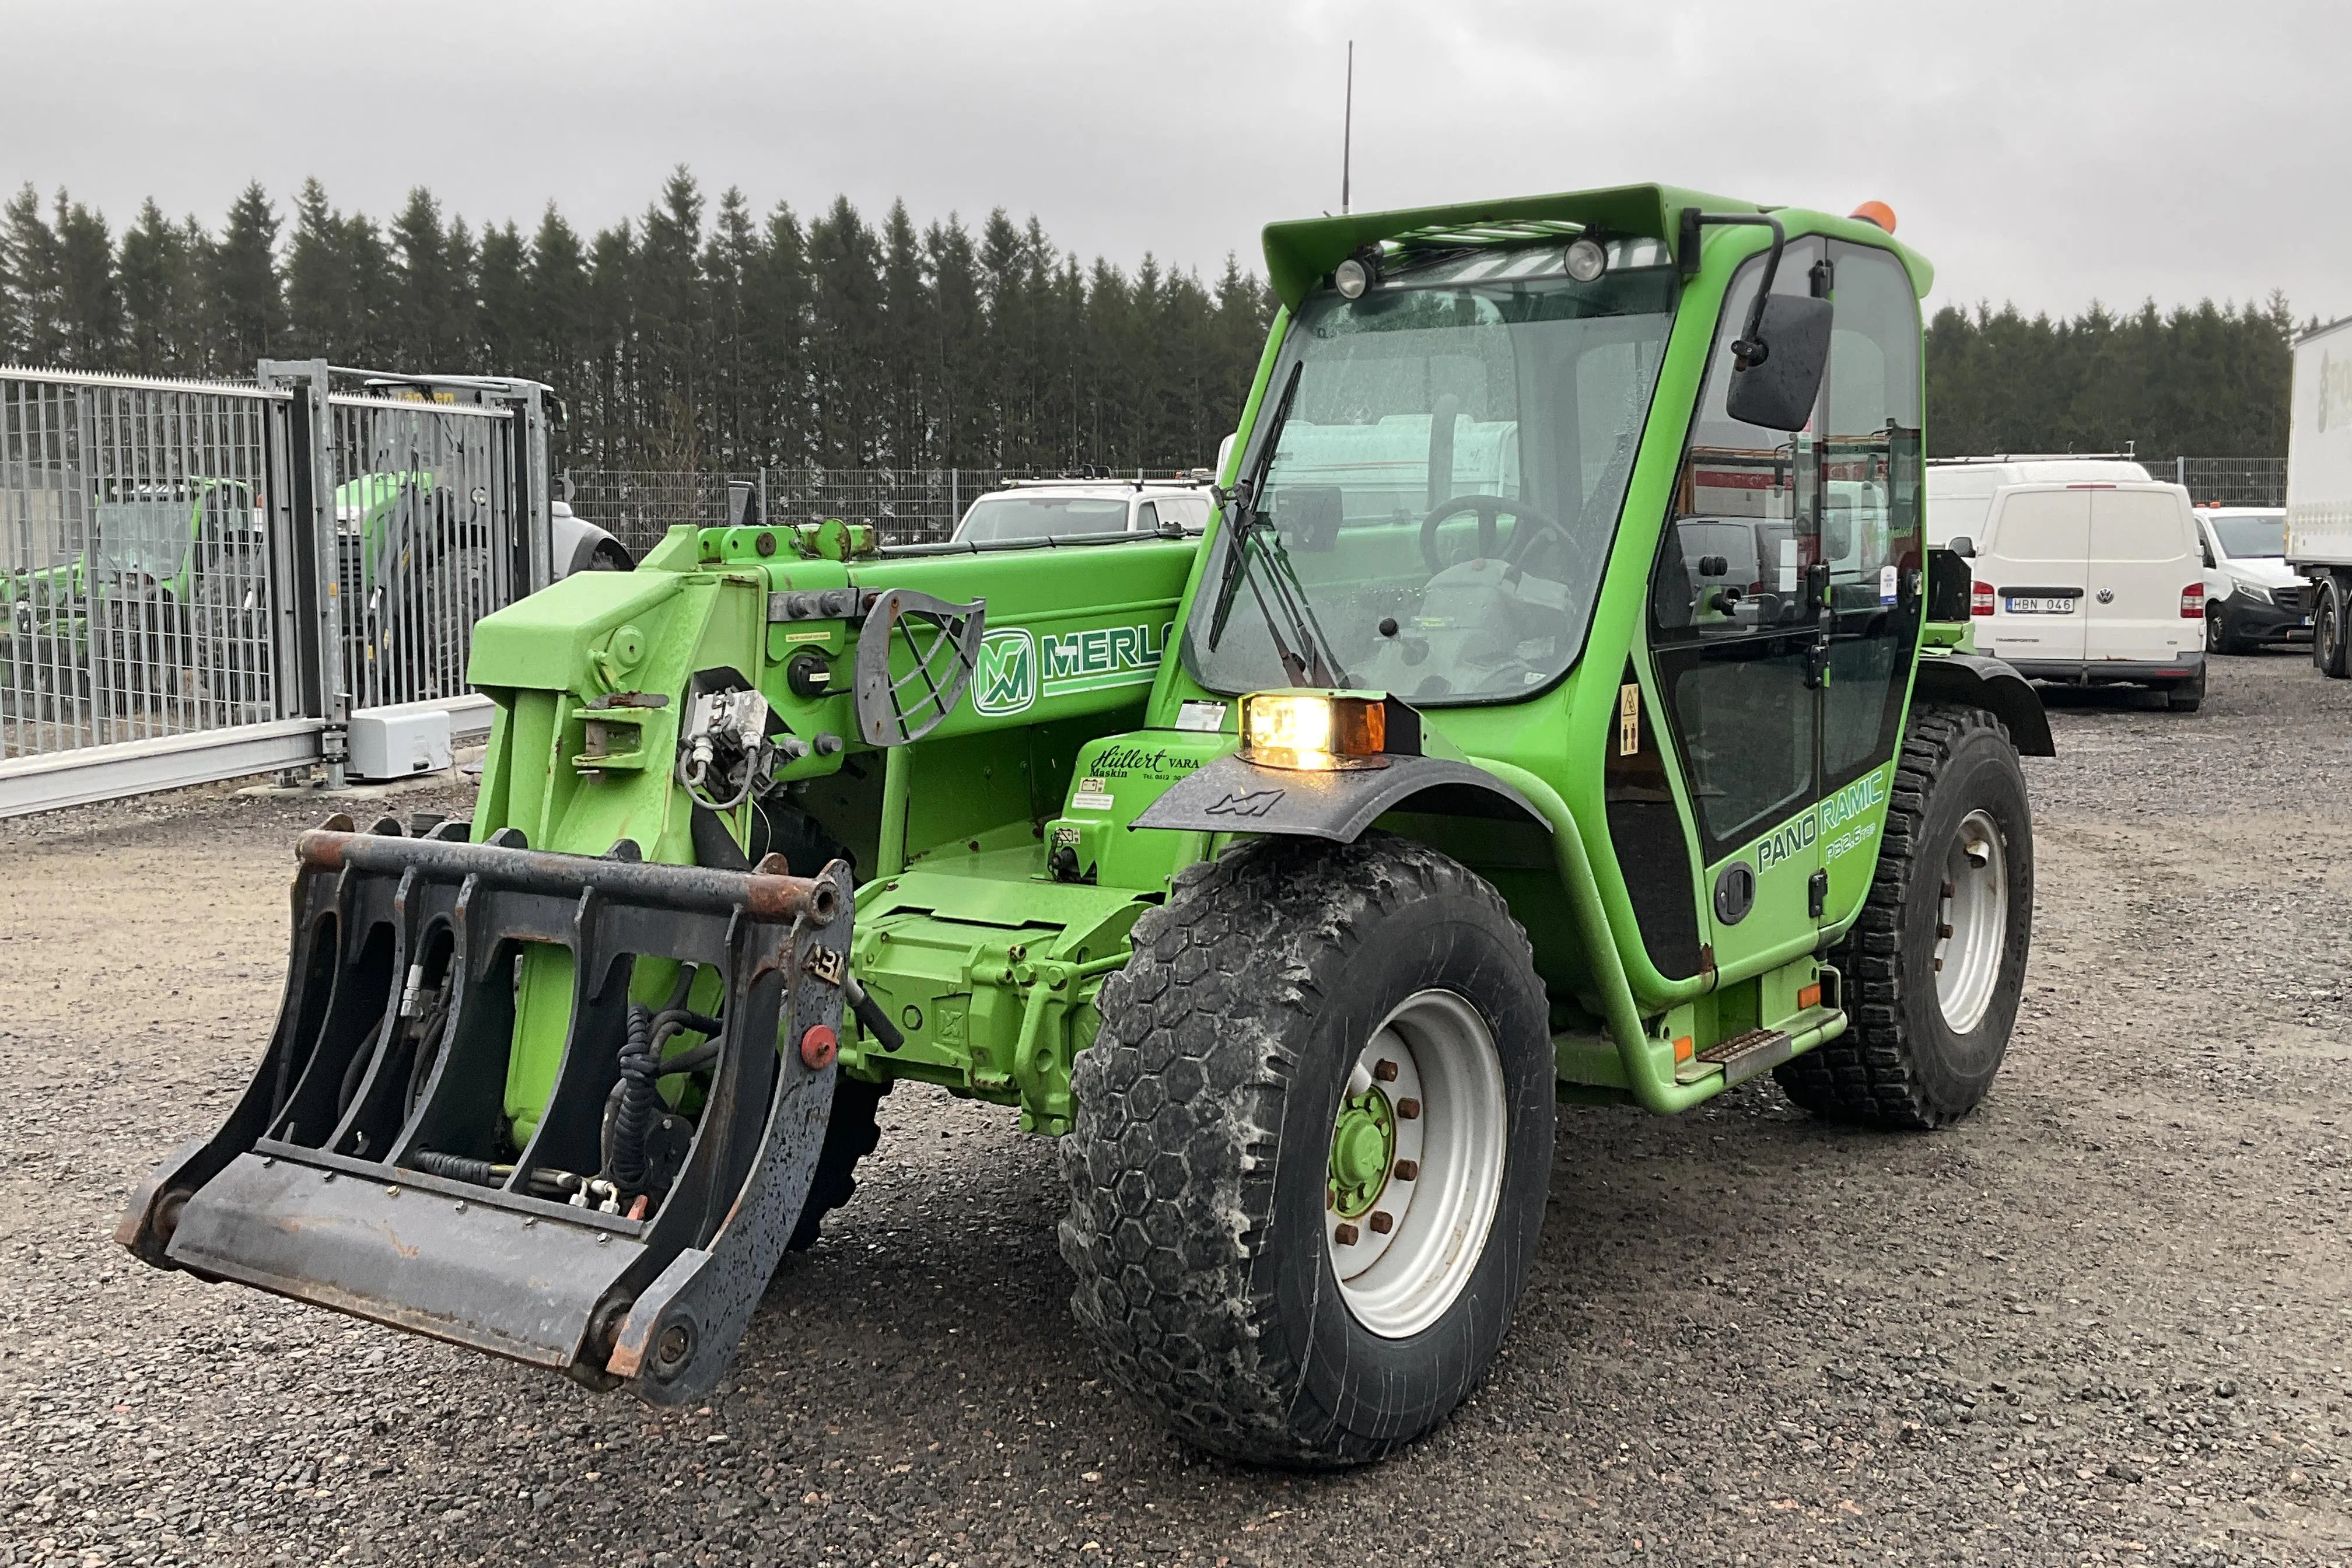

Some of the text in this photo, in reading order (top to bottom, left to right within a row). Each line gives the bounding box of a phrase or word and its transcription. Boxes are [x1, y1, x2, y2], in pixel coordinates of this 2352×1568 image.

[2014, 600, 2071, 610] HBN 046
[1091, 745, 1199, 772] Hüllert VARA
[1089, 768, 1128, 778] Maskin
